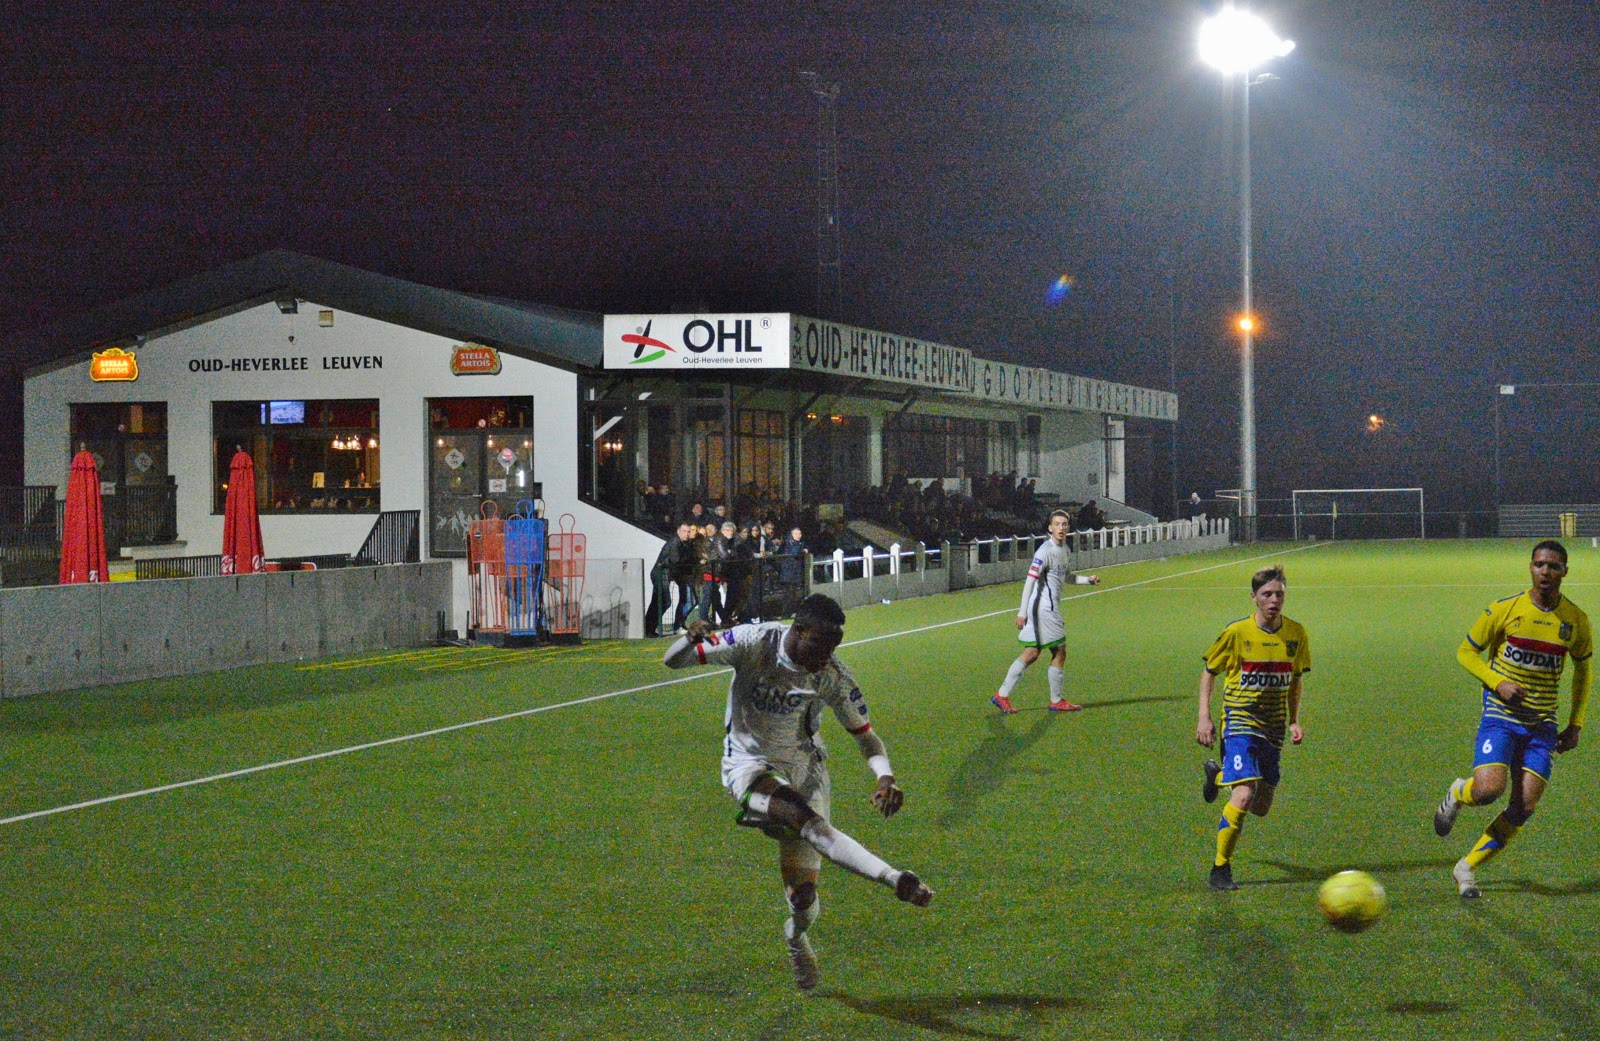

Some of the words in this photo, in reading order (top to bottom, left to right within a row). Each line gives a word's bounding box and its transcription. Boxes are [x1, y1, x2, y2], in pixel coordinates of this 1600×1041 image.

[683, 319, 762, 353] OHL
[460, 352, 491, 360] STELLA
[682, 356, 734, 364] Oud-Heverlee
[736, 356, 762, 364] Leuven
[188, 357, 308, 372] OUD-HEVERLEE
[322, 356, 383, 370] LEUVEN
[1482, 739, 1493, 754] 6
[1234, 755, 1243, 771] 8
